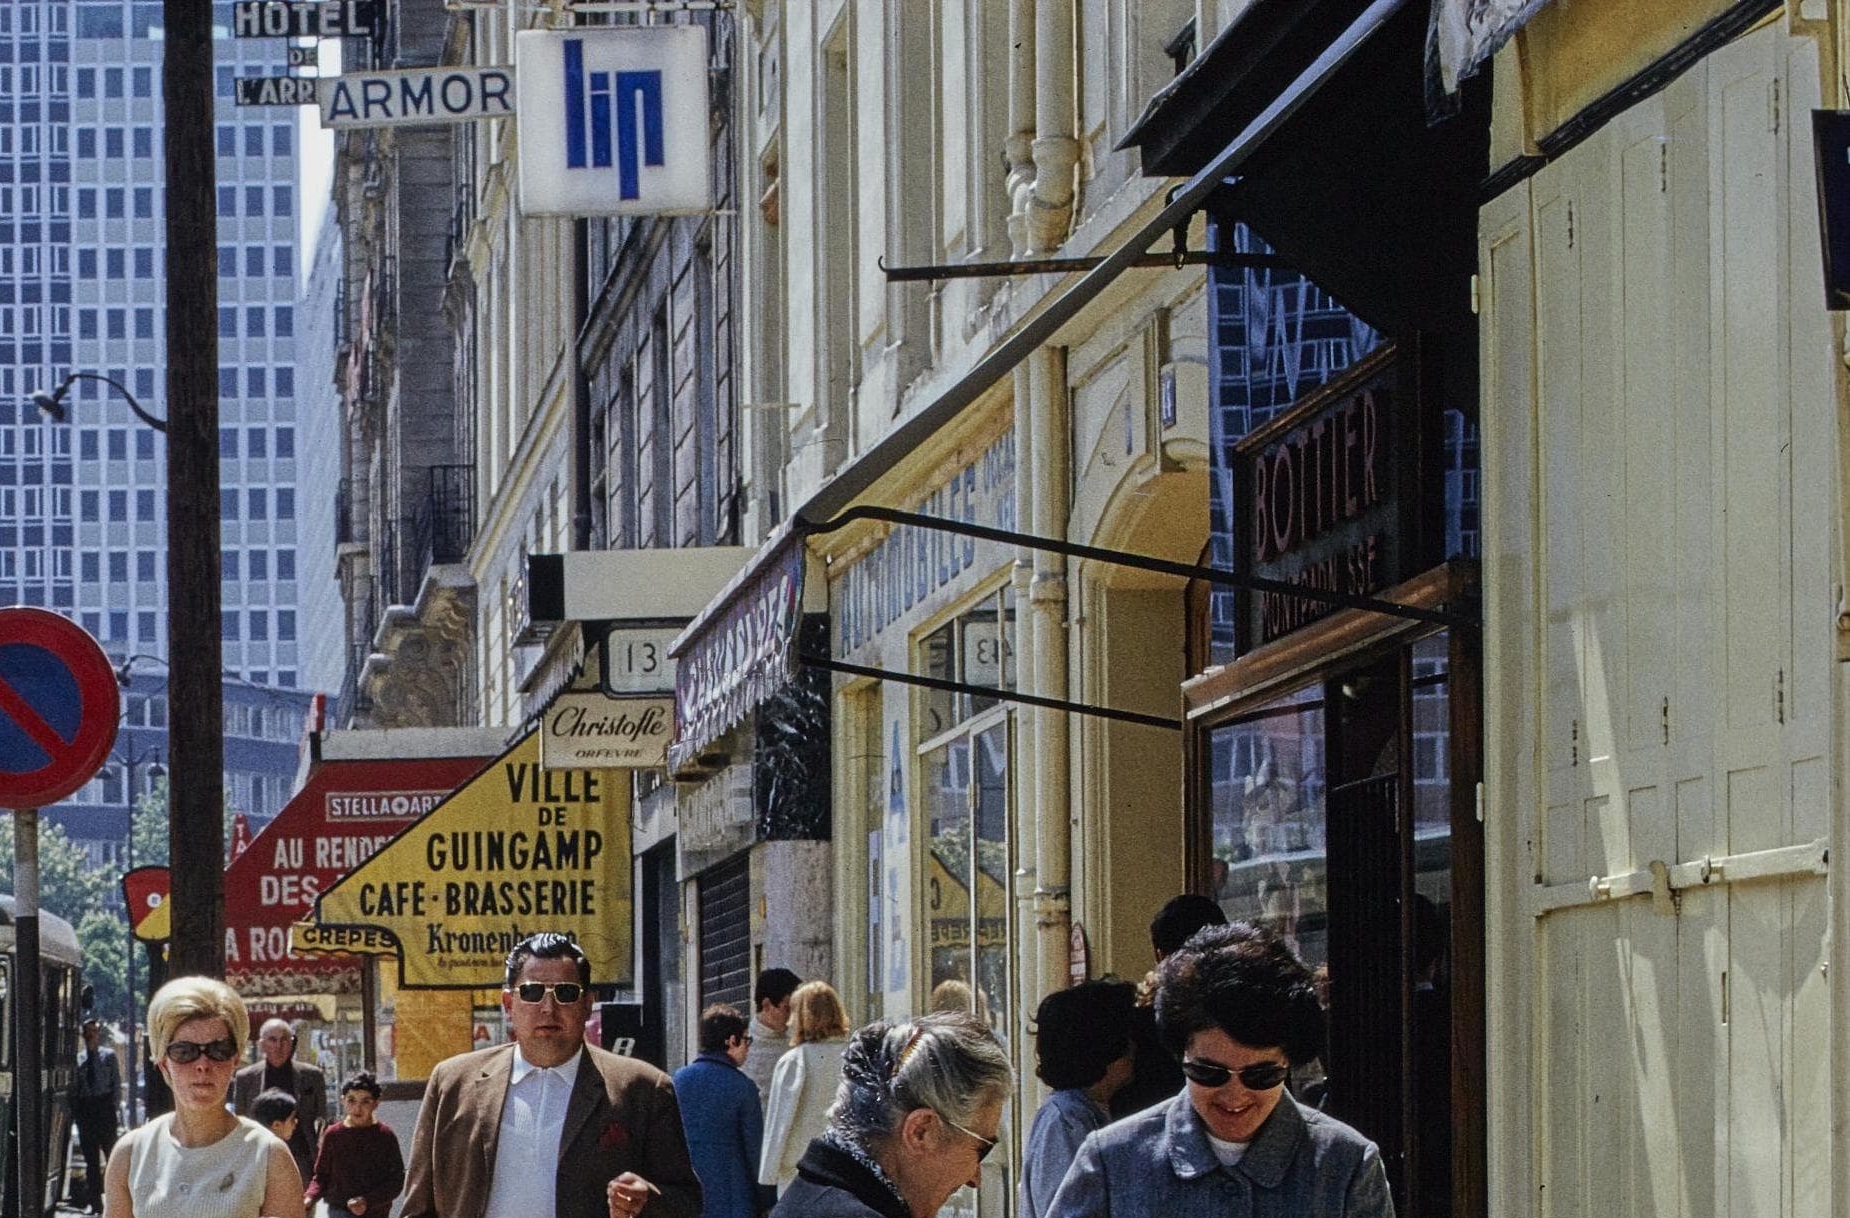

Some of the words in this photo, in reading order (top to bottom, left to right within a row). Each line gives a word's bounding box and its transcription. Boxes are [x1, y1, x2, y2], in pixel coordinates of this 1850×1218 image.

[235, 1, 370, 36] HOTEL
[327, 72, 511, 121] ARMOR
[563, 39, 665, 200] lip
[1255, 389, 1377, 563] BOTTIER
[552, 705, 667, 744] Christofle
[505, 763, 601, 803] VILLE
[331, 797, 390, 816] STELLA
[538, 806, 566, 827] DE
[274, 837, 304, 869] AU
[426, 829, 603, 872] GUINGAMP
[260, 874, 319, 906] DES
[445, 879, 595, 916] BRASSERIE
[302, 927, 397, 948] CREPES
